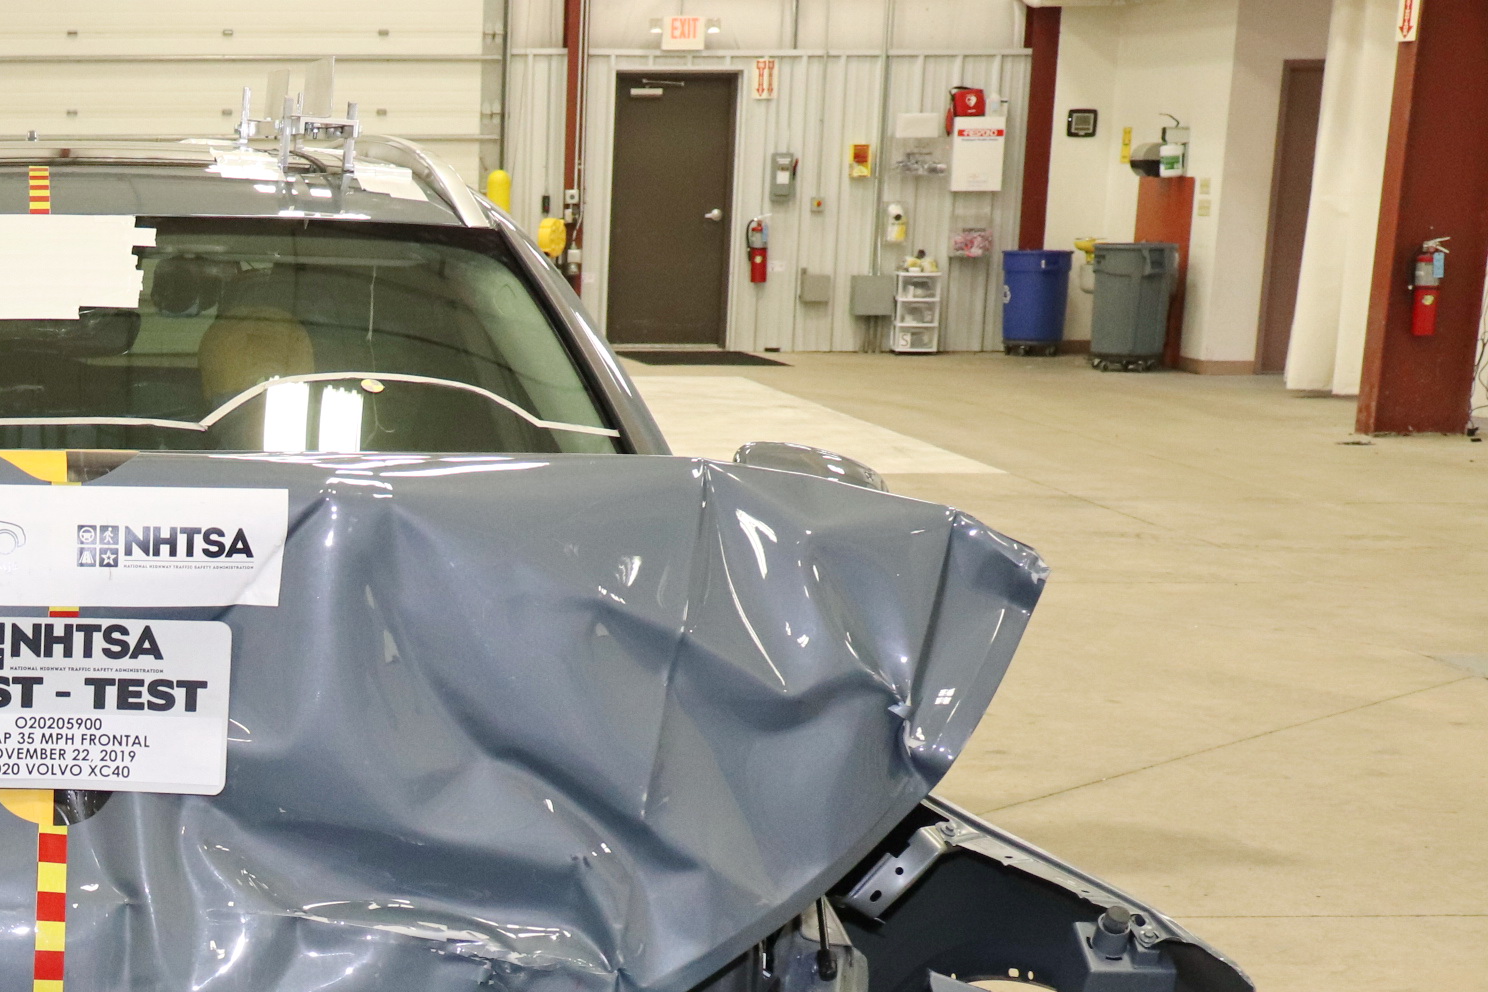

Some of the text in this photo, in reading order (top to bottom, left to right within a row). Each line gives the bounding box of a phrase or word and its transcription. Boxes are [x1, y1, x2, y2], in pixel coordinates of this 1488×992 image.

[671, 18, 699, 39] EXIT
[124, 525, 254, 558] NHTSA
[10, 622, 164, 660] NHTSA
[84, 677, 208, 712] TEST
[17, 732, 35, 745] 35
[40, 732, 75, 746] MPH
[81, 733, 150, 748] FRONTAL
[72, 748, 95, 763] 22,
[99, 749, 136, 763] 2019
[25, 763, 83, 776] VOLVO
[88, 764, 130, 778] XC40
